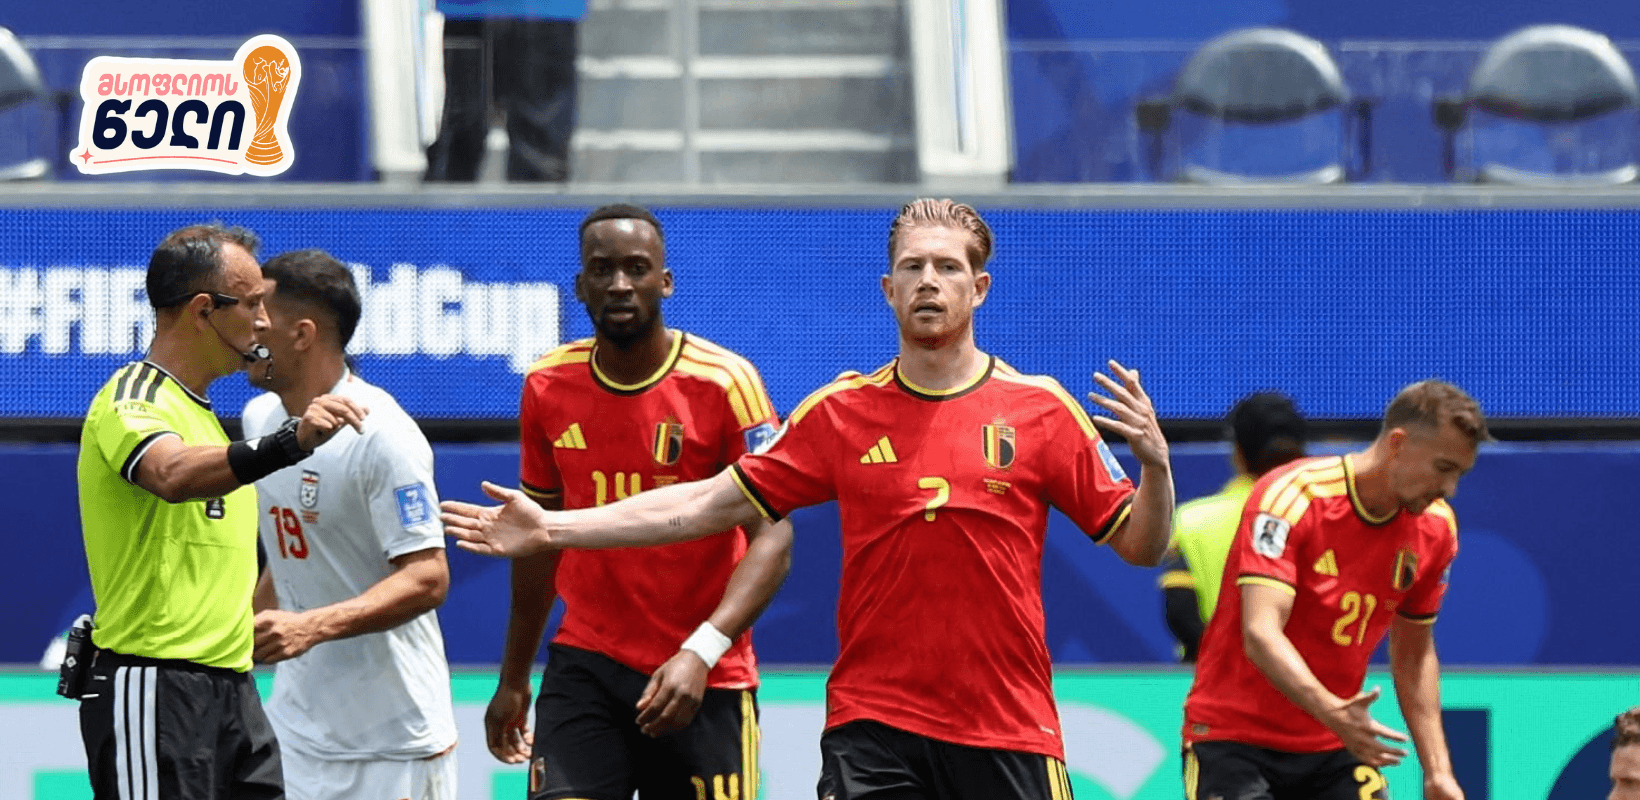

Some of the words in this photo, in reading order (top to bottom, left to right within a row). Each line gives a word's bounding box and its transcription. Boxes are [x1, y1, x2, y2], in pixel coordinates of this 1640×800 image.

[592, 470, 641, 507] 14
[918, 477, 950, 521] 7
[269, 506, 309, 559] 19
[1332, 591, 1377, 646] 21
[1354, 766, 1386, 800] 2
